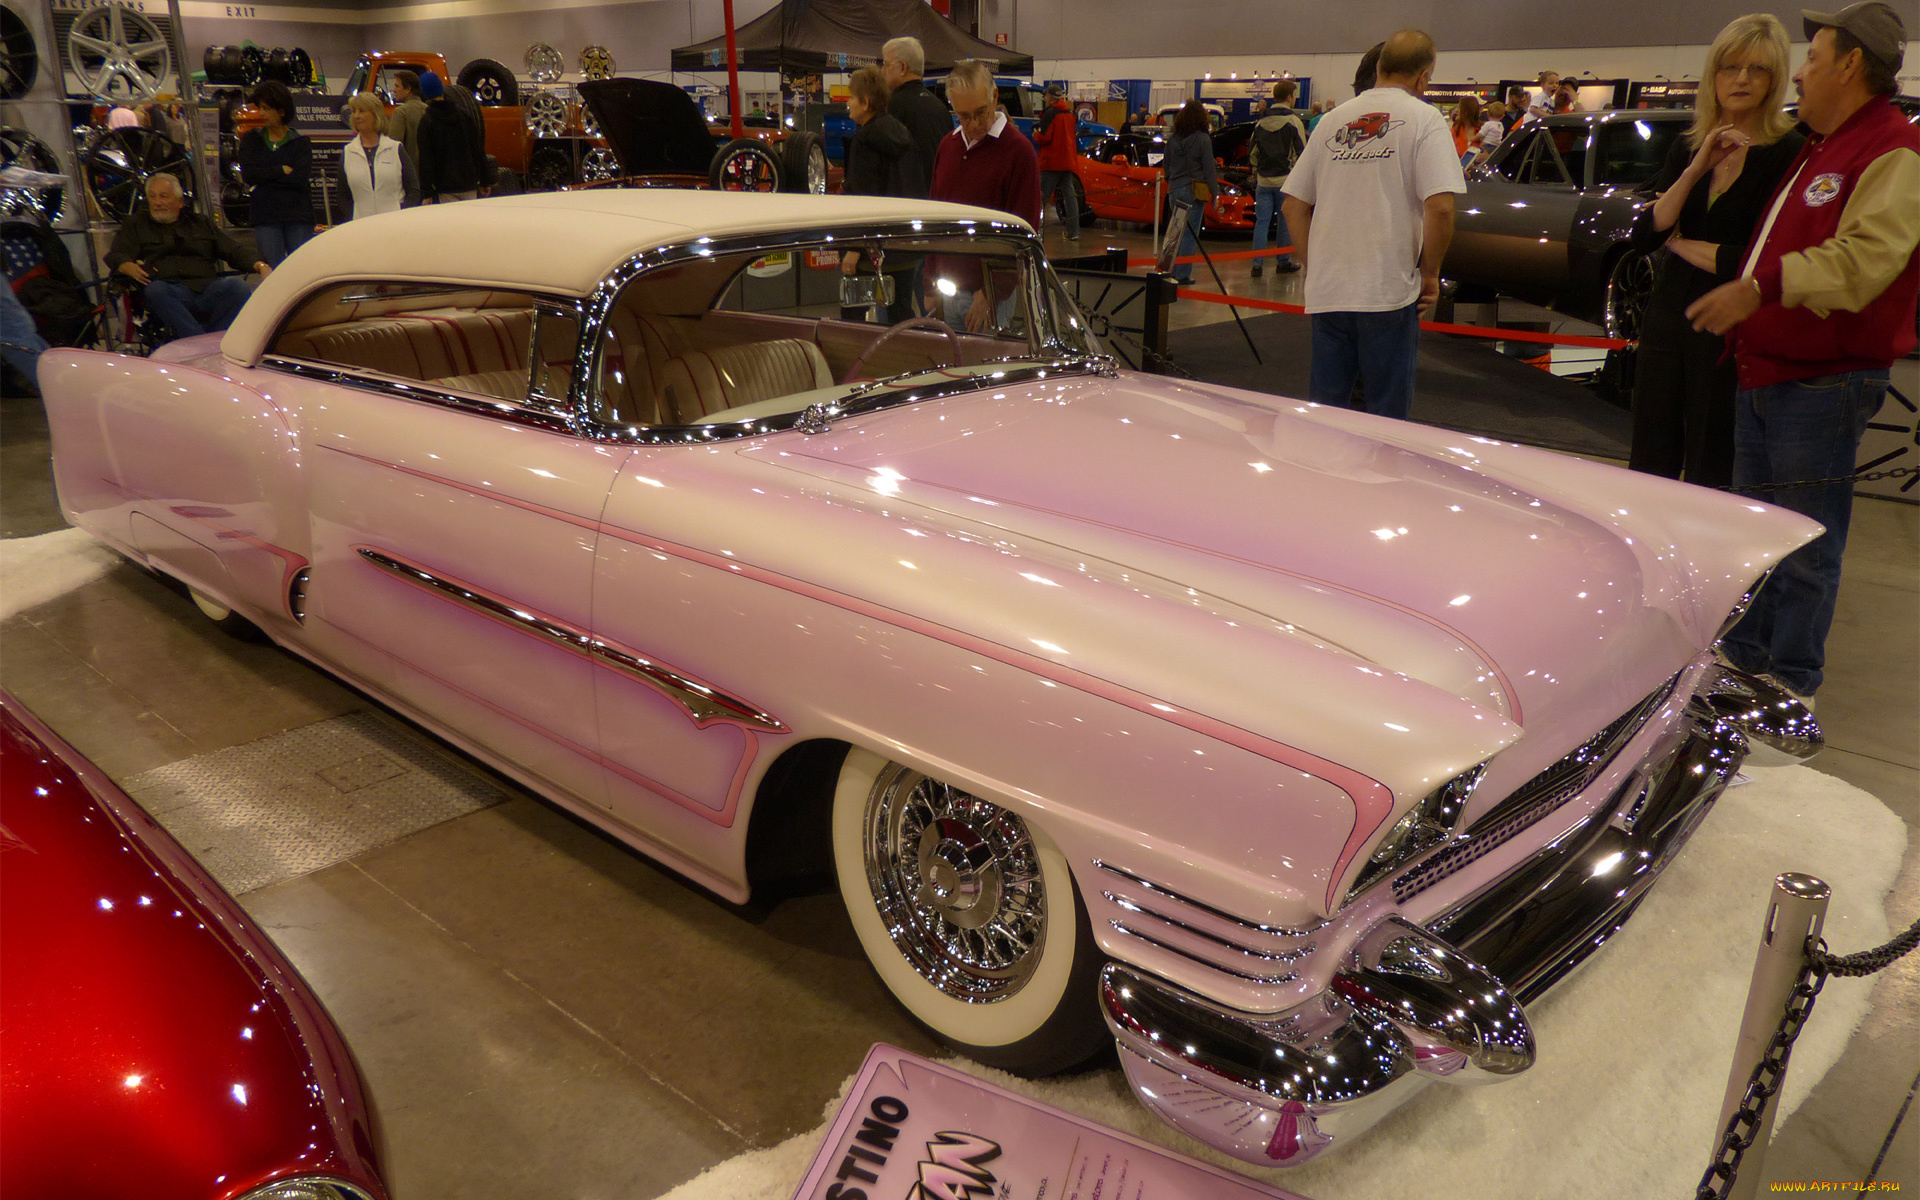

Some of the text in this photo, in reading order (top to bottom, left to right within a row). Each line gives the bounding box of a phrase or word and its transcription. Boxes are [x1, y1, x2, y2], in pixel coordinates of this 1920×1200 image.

[225, 6, 256, 17] EXIT
[296, 106, 331, 114] BEST BRAKE
